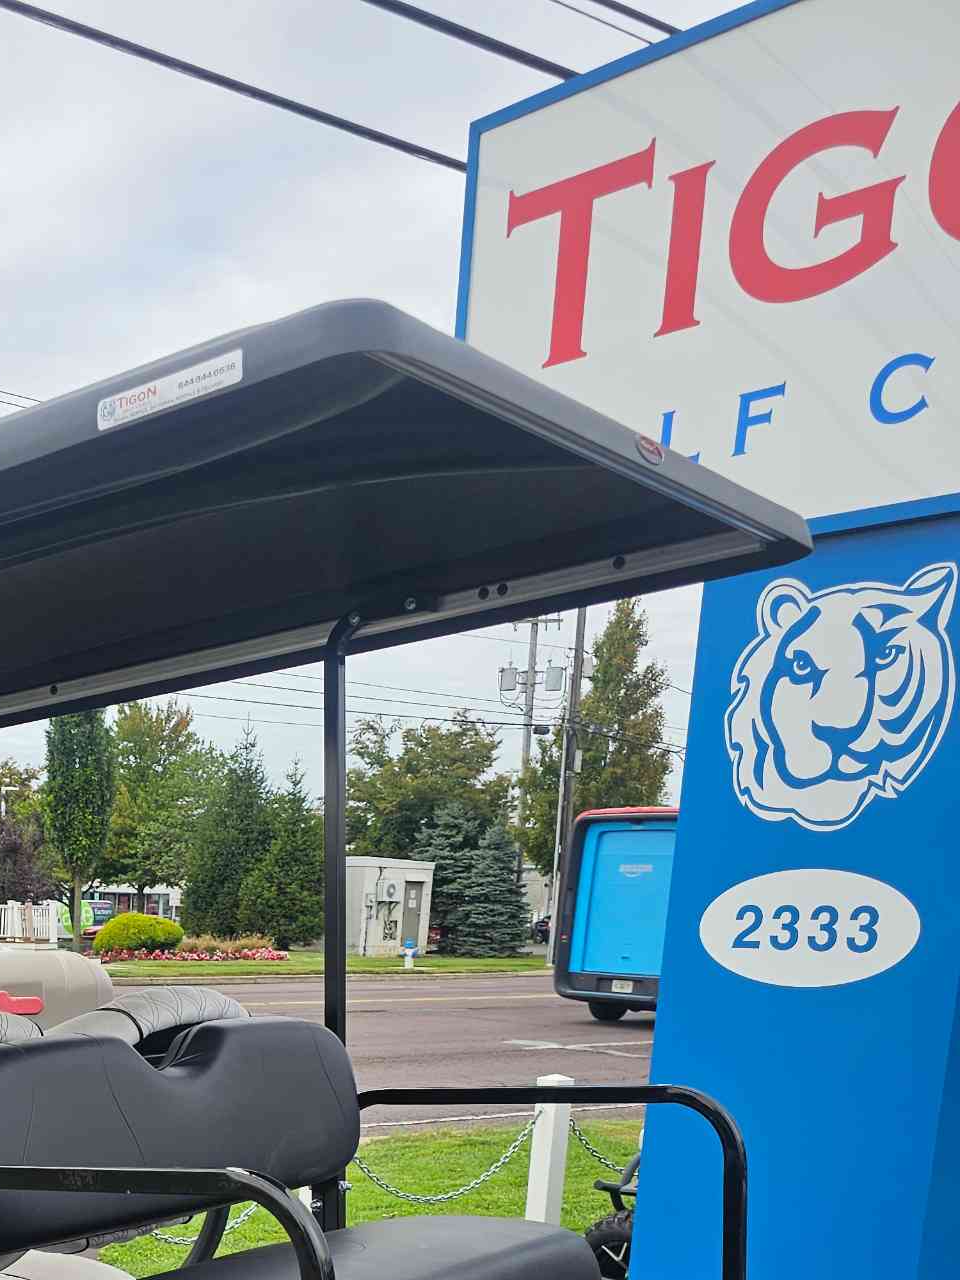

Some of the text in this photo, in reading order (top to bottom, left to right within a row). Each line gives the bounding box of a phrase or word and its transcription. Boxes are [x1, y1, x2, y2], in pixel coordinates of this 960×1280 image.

[506, 102, 960, 369] TIG
[118, 385, 157, 409] TIGON
[732, 904, 880, 954] 2333
